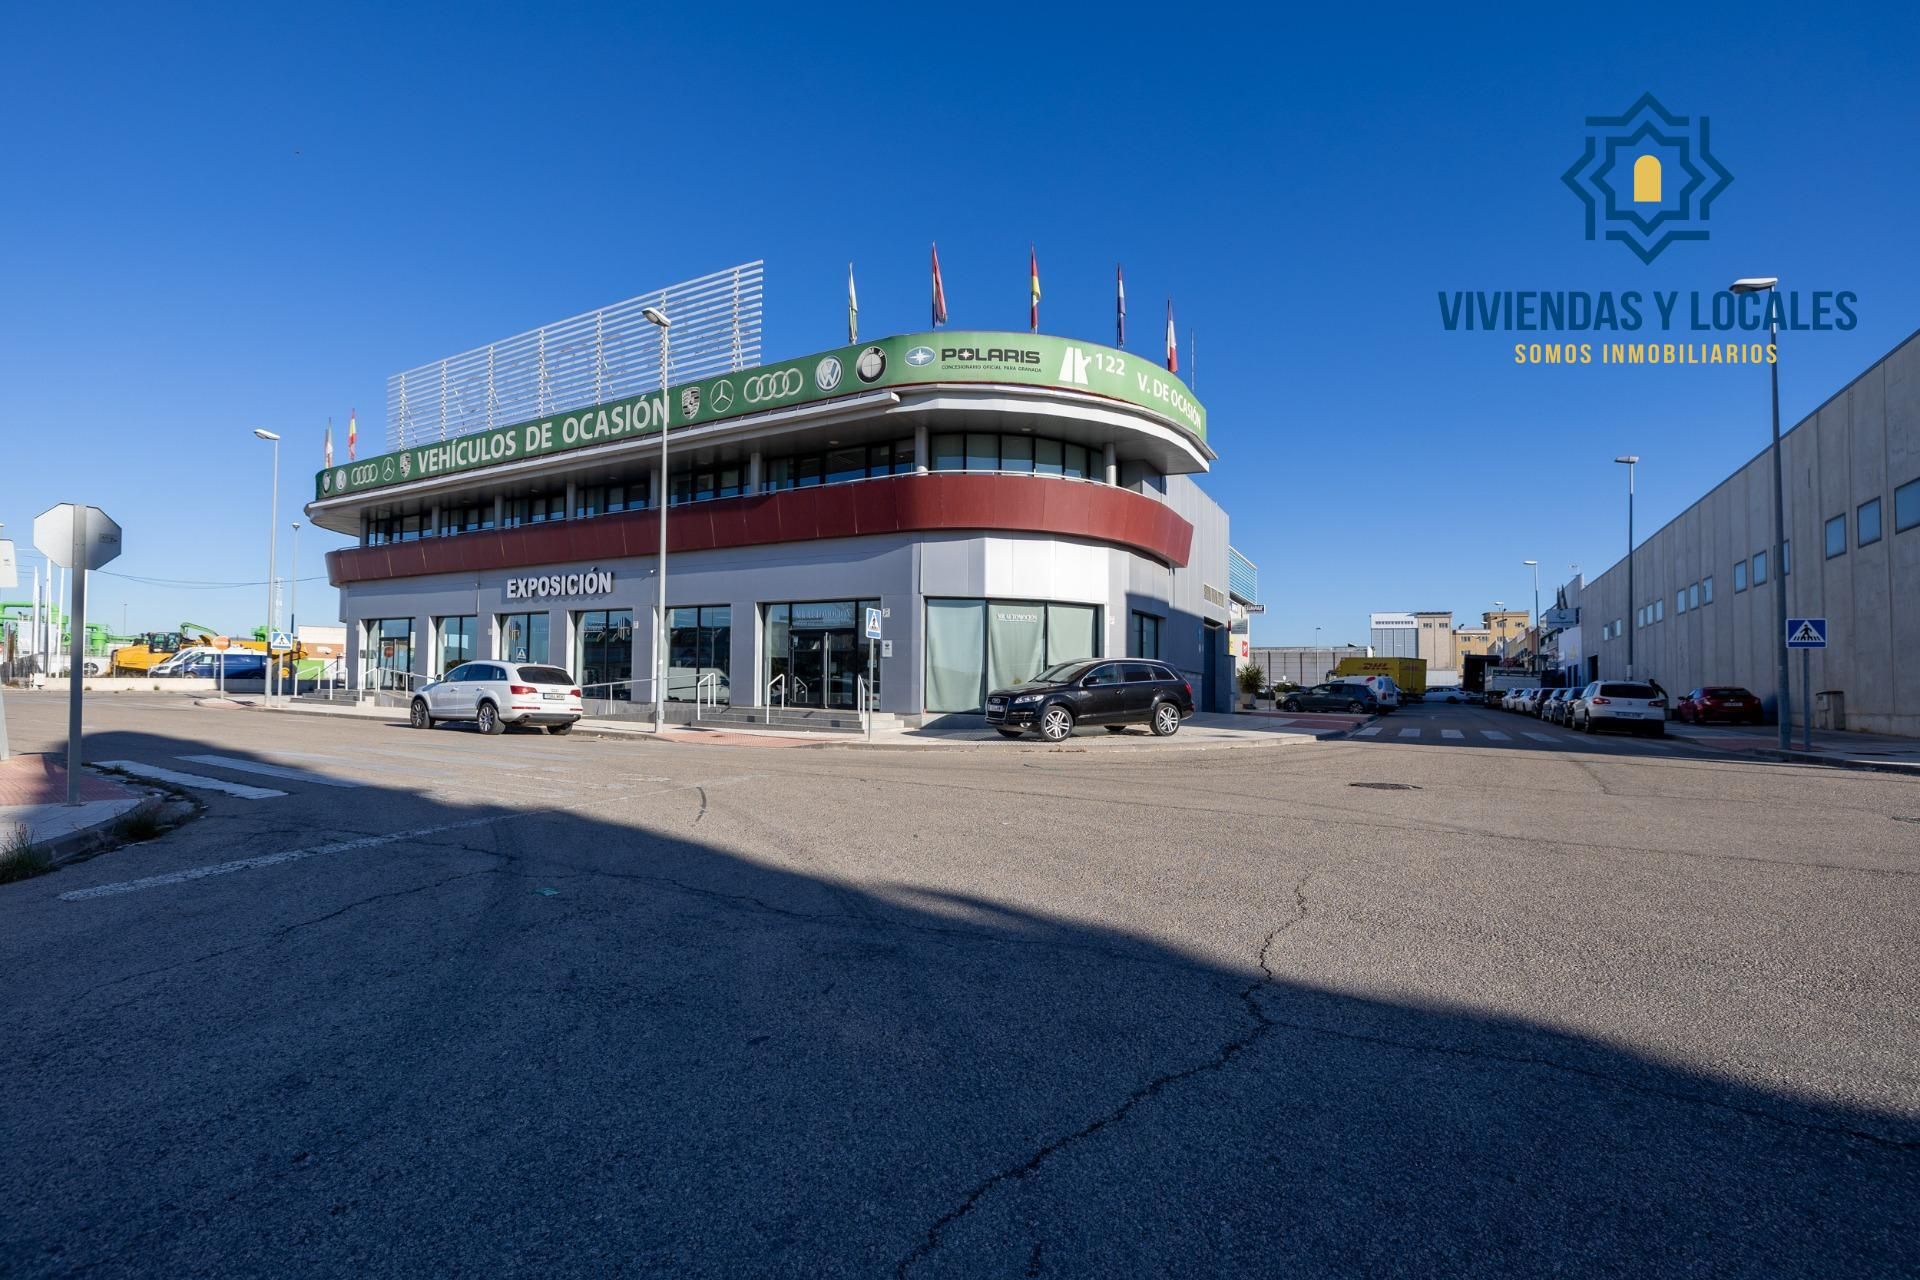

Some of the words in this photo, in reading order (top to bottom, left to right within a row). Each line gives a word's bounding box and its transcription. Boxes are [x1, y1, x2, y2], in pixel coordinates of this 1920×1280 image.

[941, 347, 1041, 364] POLARIS
[1095, 353, 1125, 376] 122
[1137, 371, 1151, 393] V.
[1153, 379, 1169, 402] DE
[1170, 389, 1201, 430] OCASIÓN
[417, 430, 516, 474] VEHÍCULOS
[525, 422, 553, 453] DE
[562, 394, 670, 444] OCASIÓN
[506, 566, 612, 599] EXPOSICIÓN
